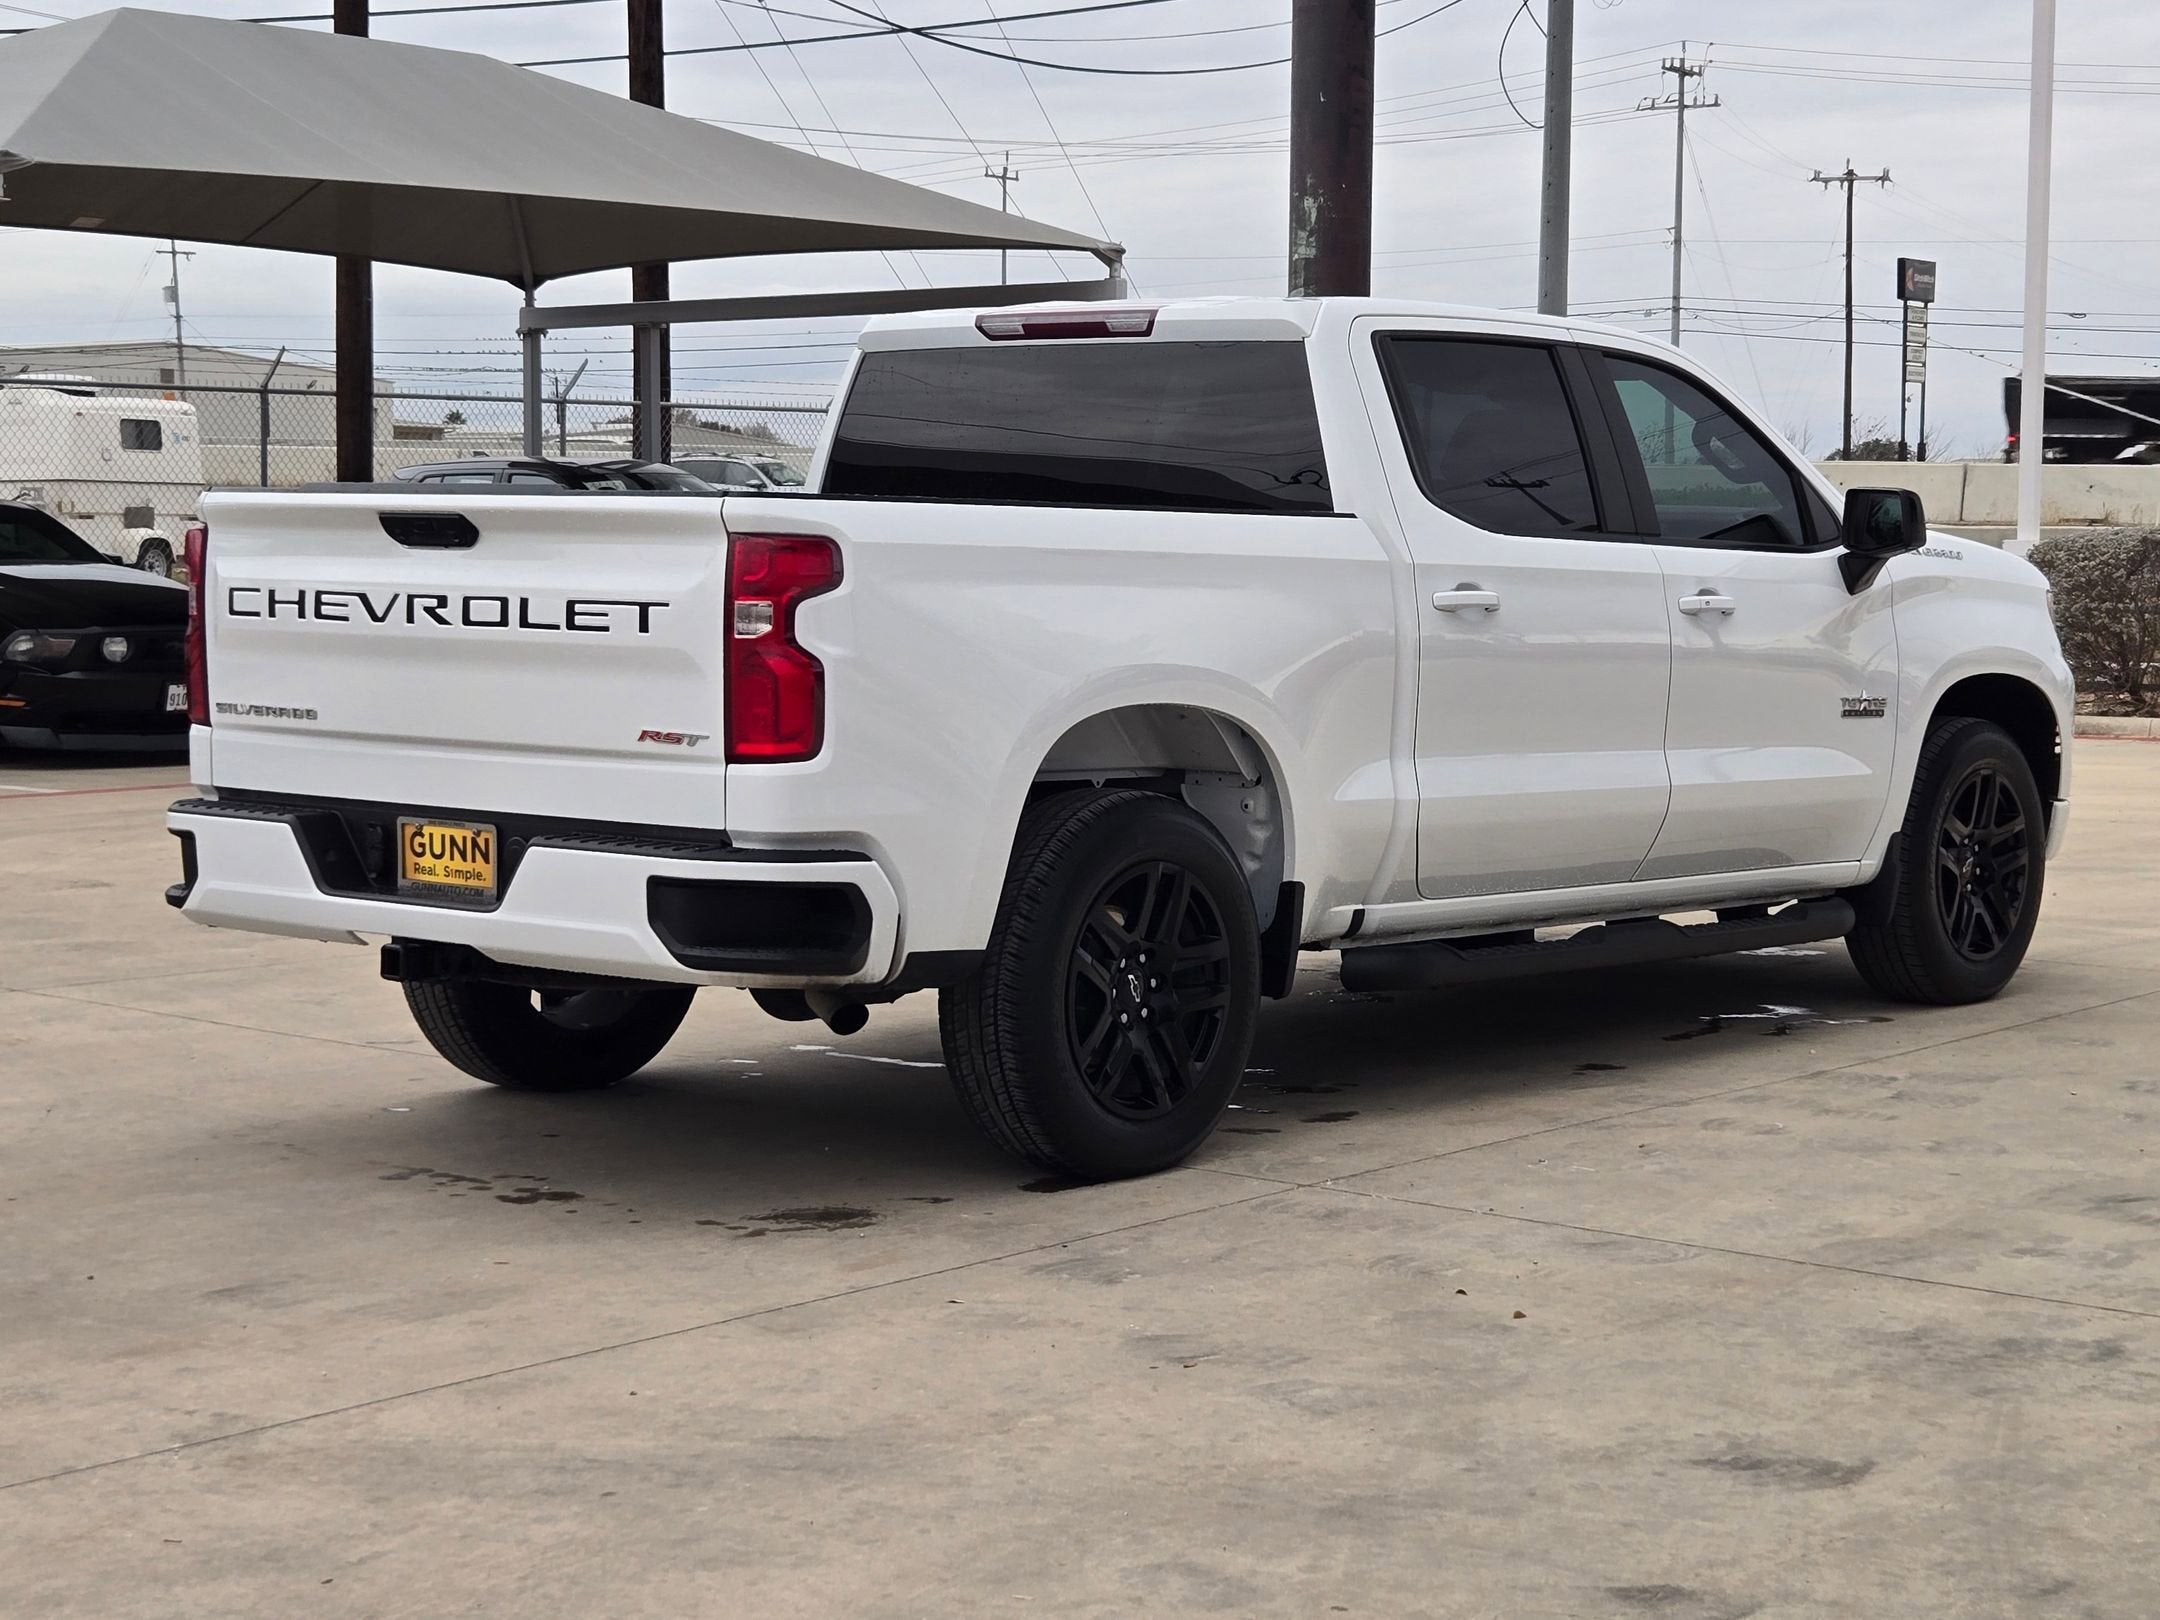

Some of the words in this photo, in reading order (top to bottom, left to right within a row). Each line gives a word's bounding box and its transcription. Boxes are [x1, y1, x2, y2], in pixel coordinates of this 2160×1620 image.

[228, 587, 670, 634] CHEVROLET
[637, 729, 711, 747] RST
[409, 830, 491, 865] GUNN
[413, 862, 440, 877] Real.
[443, 865, 487, 882] Simple.
